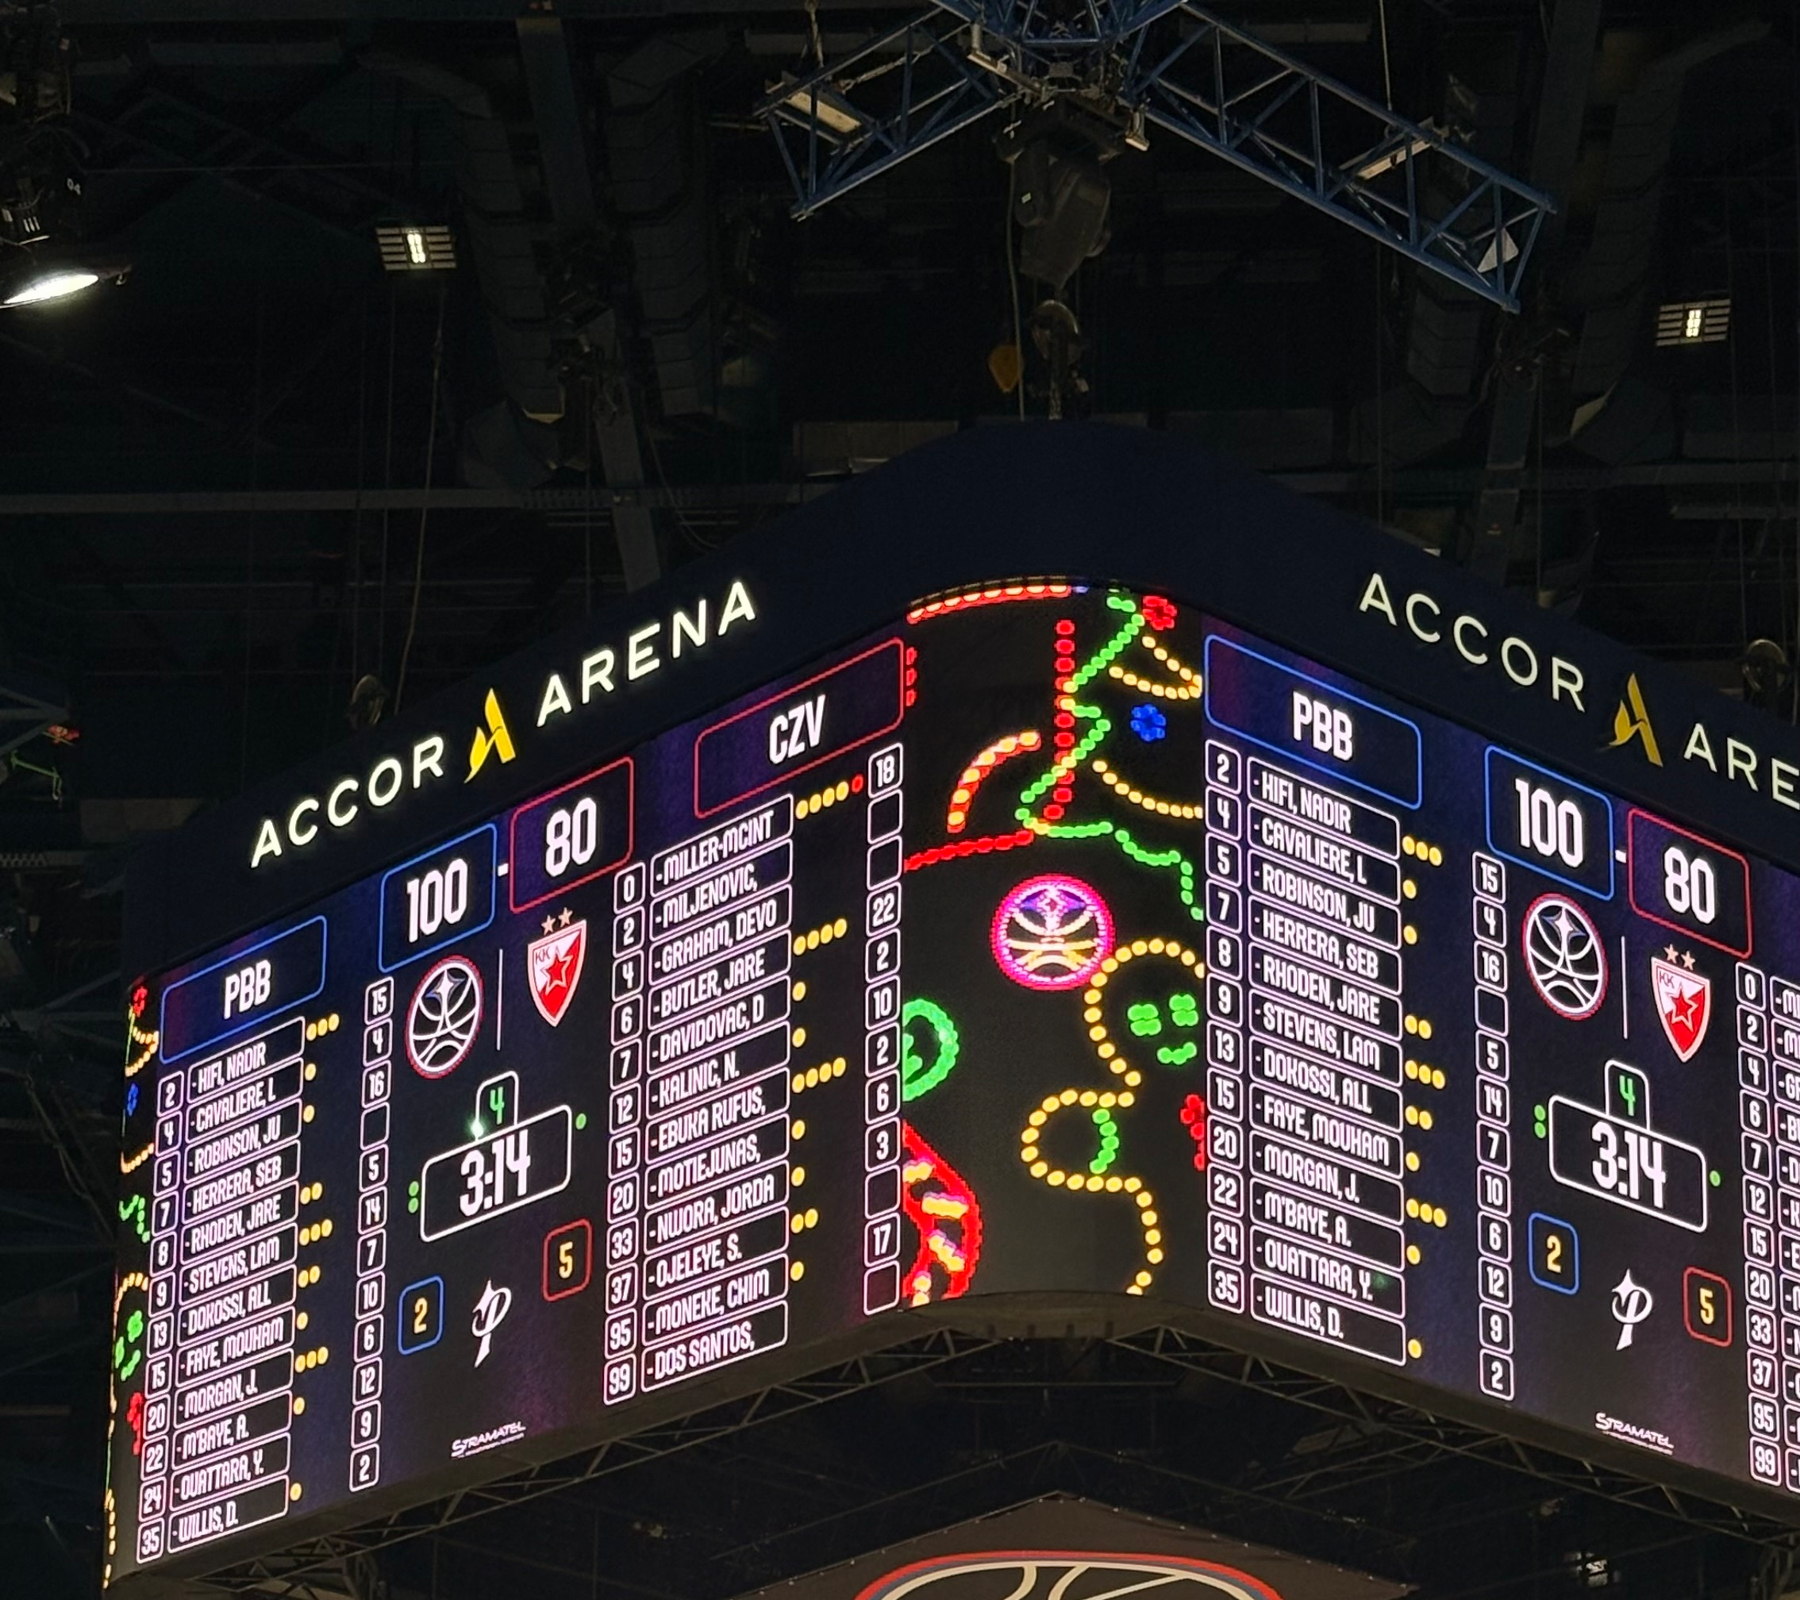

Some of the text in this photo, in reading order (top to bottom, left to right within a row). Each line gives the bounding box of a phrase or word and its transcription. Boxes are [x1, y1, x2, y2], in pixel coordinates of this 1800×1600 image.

[250, 580, 756, 869] ACCOR ARENA
[1359, 572, 1800, 811] ACCOR ARE
[769, 694, 826, 765] CZV
[1293, 690, 1352, 761] PBB
[876, 755, 895, 787] 18
[1217, 754, 1351, 833] 2 HIFI, NADIR
[406, 797, 597, 943] 100 80
[1217, 798, 1230, 828] 4
[1263, 818, 1355, 883] CAVALIERE,
[1515, 778, 1716, 925] 100 80
[624, 875, 635, 902] 0
[873, 893, 894, 927] 22
[1218, 845, 1374, 932] 5 ROBINSON, JU
[623, 899, 776, 988] 4 GRAHAM, DEVO
[624, 917, 634, 945] 2
[877, 941, 889, 971] 2
[1218, 892, 1378, 979] 7 HERRERA, SEB
[224, 959, 271, 1019] PBB
[372, 986, 387, 1015] 15
[621, 948, 765, 1034] 6 BUTLER, JARE
[874, 987, 892, 1019] 10
[1218, 938, 1379, 1025] 8 RHODEN, JARE
[373, 1028, 383, 1053] 4
[620, 1050, 631, 1078] 7
[660, 1002, 750, 1062] DAVIDOVAC,
[877, 1035, 888, 1065] 2
[1218, 985, 1380, 1070] 9 STEVENS, LAM
[165, 1042, 266, 1108] 2 HIFI, NADIR
[369, 1071, 384, 1099] 16
[489, 1087, 505, 1124] 4
[617, 1051, 739, 1124] 12 KALINIC, N.
[877, 1082, 889, 1111] 6
[1216, 1030, 1372, 1114] 13 DOKOSSI, ALL
[164, 1121, 174, 1145] 4
[196, 1082, 266, 1132] CAVALIERE,
[616, 1086, 765, 1168] 15 EBUKA RUFUS,
[877, 1131, 888, 1160] 3
[1216, 1077, 1389, 1166] 15 FAYE, MOUHAM
[162, 1115, 281, 1186] 5 ROBINSON, JU
[369, 1154, 379, 1181] 5
[459, 1129, 531, 1217] 3:14
[613, 1134, 760, 1214] 20 MOTIEJUNAS,
[1214, 1126, 1360, 1203] 20 MORGAN, J.
[1591, 1121, 1667, 1209] 3:14
[161, 1155, 281, 1227] 7 HERRERA, SEB
[365, 1196, 381, 1225] 14
[612, 1174, 774, 1259] 33 NWORA, JORDA
[1214, 1174, 1351, 1247] 22 M'BAYE, A.
[158, 1194, 281, 1266] 8 RHODEN, JARE
[367, 1239, 377, 1266] 7
[559, 1241, 574, 1279] 5
[874, 1223, 891, 1255] 17
[1214, 1222, 1373, 1301] 24 OUATTARA, Y.
[1546, 1235, 1562, 1274] 2
[157, 1236, 279, 1306] 9 STEVENS, LAM
[363, 1281, 378, 1309] 10
[611, 1233, 742, 1304] 37 OJELEYE, S.
[153, 1281, 271, 1348] 13 DOKOSSI, ALL
[364, 1324, 374, 1350] 6
[414, 1298, 428, 1334] 2
[610, 1269, 769, 1350] 95 MONEKE, CHIM
[1215, 1270, 1344, 1339] 35 WILLIS, D.
[1700, 1288, 1715, 1325] 5
[152, 1317, 284, 1389] 15 FAYE, MOUHAM
[360, 1367, 375, 1395] 12
[609, 1321, 755, 1395] 99 DOS SANTOS,
[148, 1369, 258, 1432] 20 MORGAN, J.
[361, 1411, 371, 1437] 9
[1595, 1412, 1675, 1449] STRAMATEL
[146, 1414, 249, 1472] 22 M'BAYE, A.
[359, 1455, 370, 1482] 2
[450, 1421, 527, 1457] STRAMATEL
[143, 1449, 264, 1514] 24 OUATTARA, Y.
[141, 1501, 238, 1555] 35 WILLIS, D.
